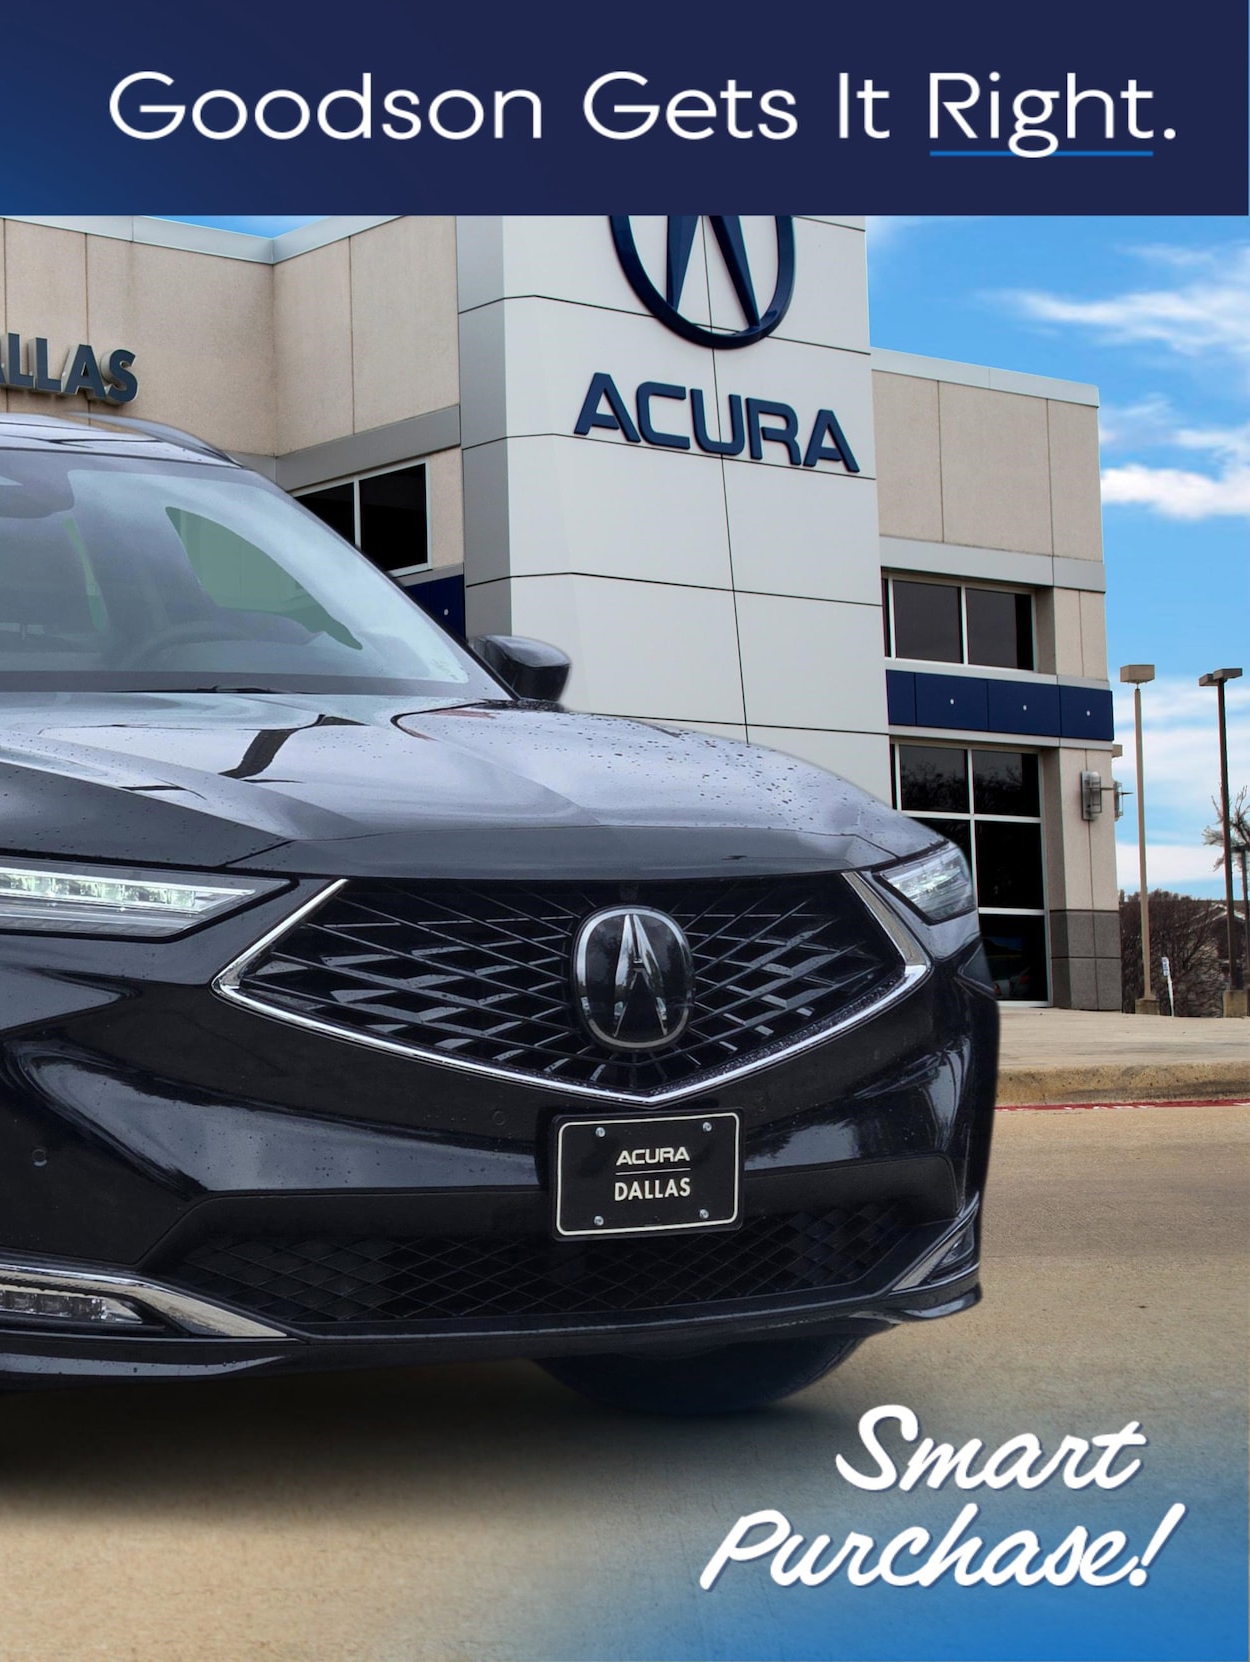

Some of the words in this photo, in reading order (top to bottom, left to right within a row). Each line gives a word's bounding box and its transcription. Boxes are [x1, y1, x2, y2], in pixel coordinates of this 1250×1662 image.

[574, 372, 859, 473] ACURA
[615, 1146, 690, 1166] ACURA
[614, 1177, 691, 1202] DALLAS
